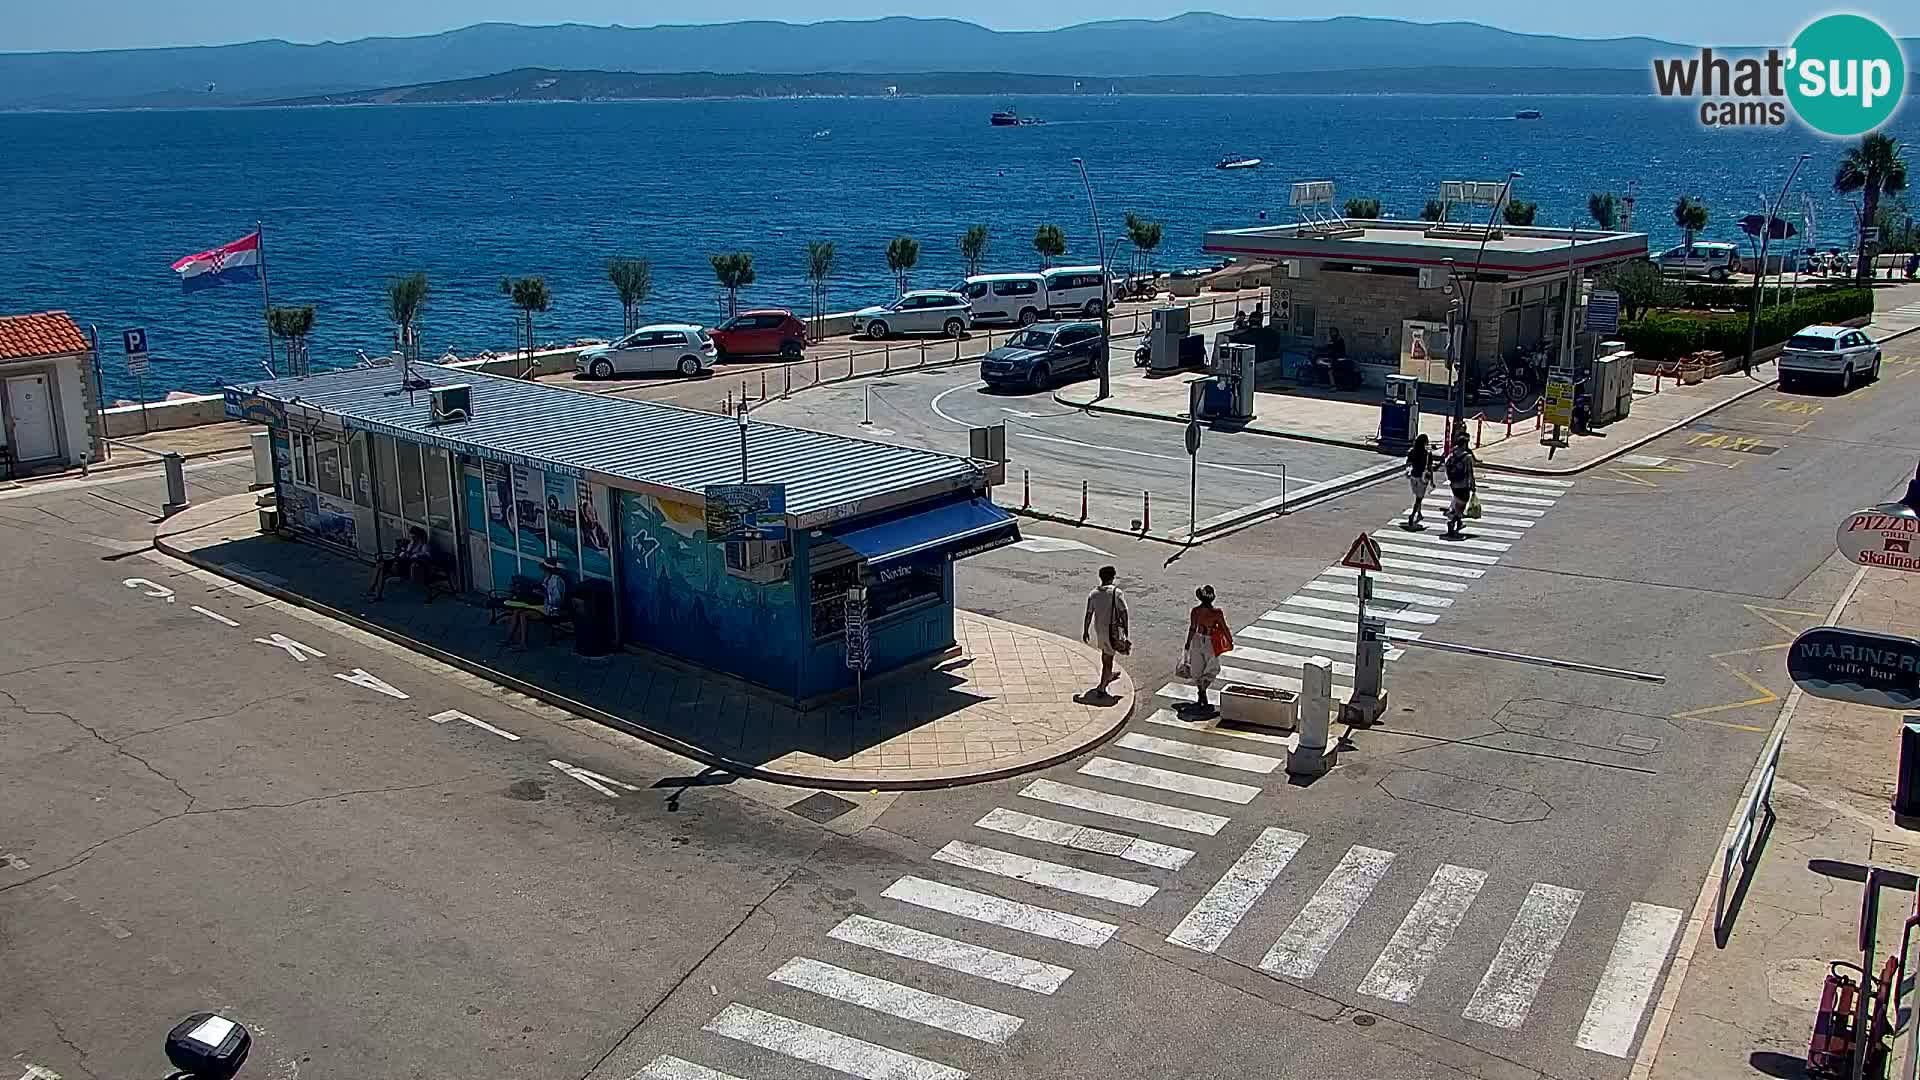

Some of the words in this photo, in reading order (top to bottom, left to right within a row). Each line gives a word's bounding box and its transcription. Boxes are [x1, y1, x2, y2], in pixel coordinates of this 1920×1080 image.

[128, 332, 140, 351] P
[1685, 432, 1764, 453] TAXI
[477, 447, 491, 459] BUS
[493, 451, 525, 466] STATION
[528, 458, 553, 473] TICKET
[554, 462, 581, 478] OFFICE
[1848, 515, 1920, 533] PIZZE
[1881, 530, 1917, 541] GRILL
[1870, 666, 1897, 680] bar
